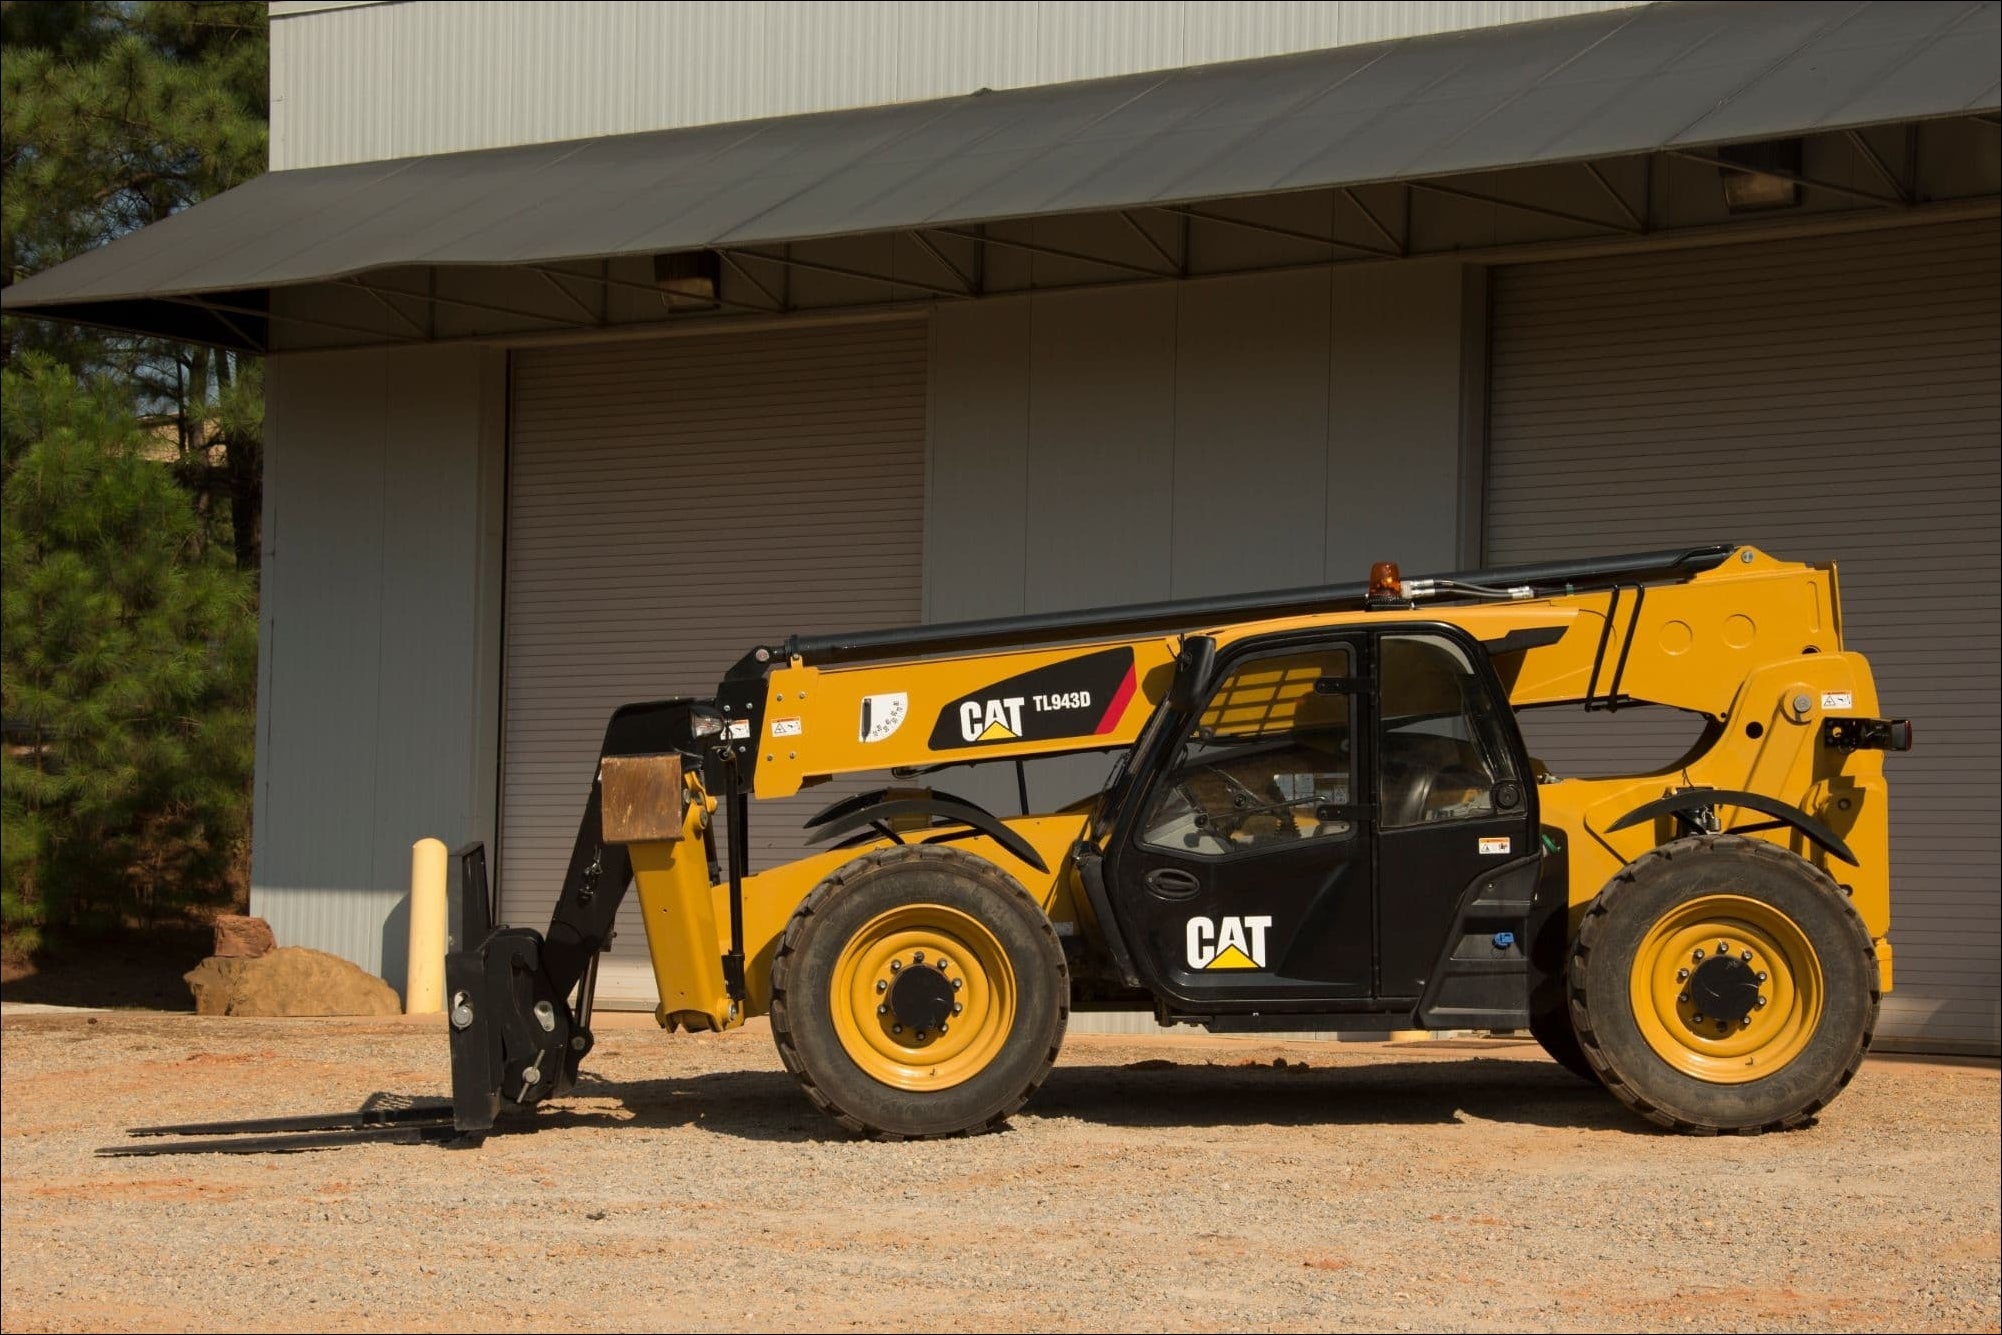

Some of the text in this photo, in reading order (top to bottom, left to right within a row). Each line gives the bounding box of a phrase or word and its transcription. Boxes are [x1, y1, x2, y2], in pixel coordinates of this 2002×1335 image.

[959, 690, 1092, 742] CAT TL943D
[1186, 915, 1273, 970] CAT
